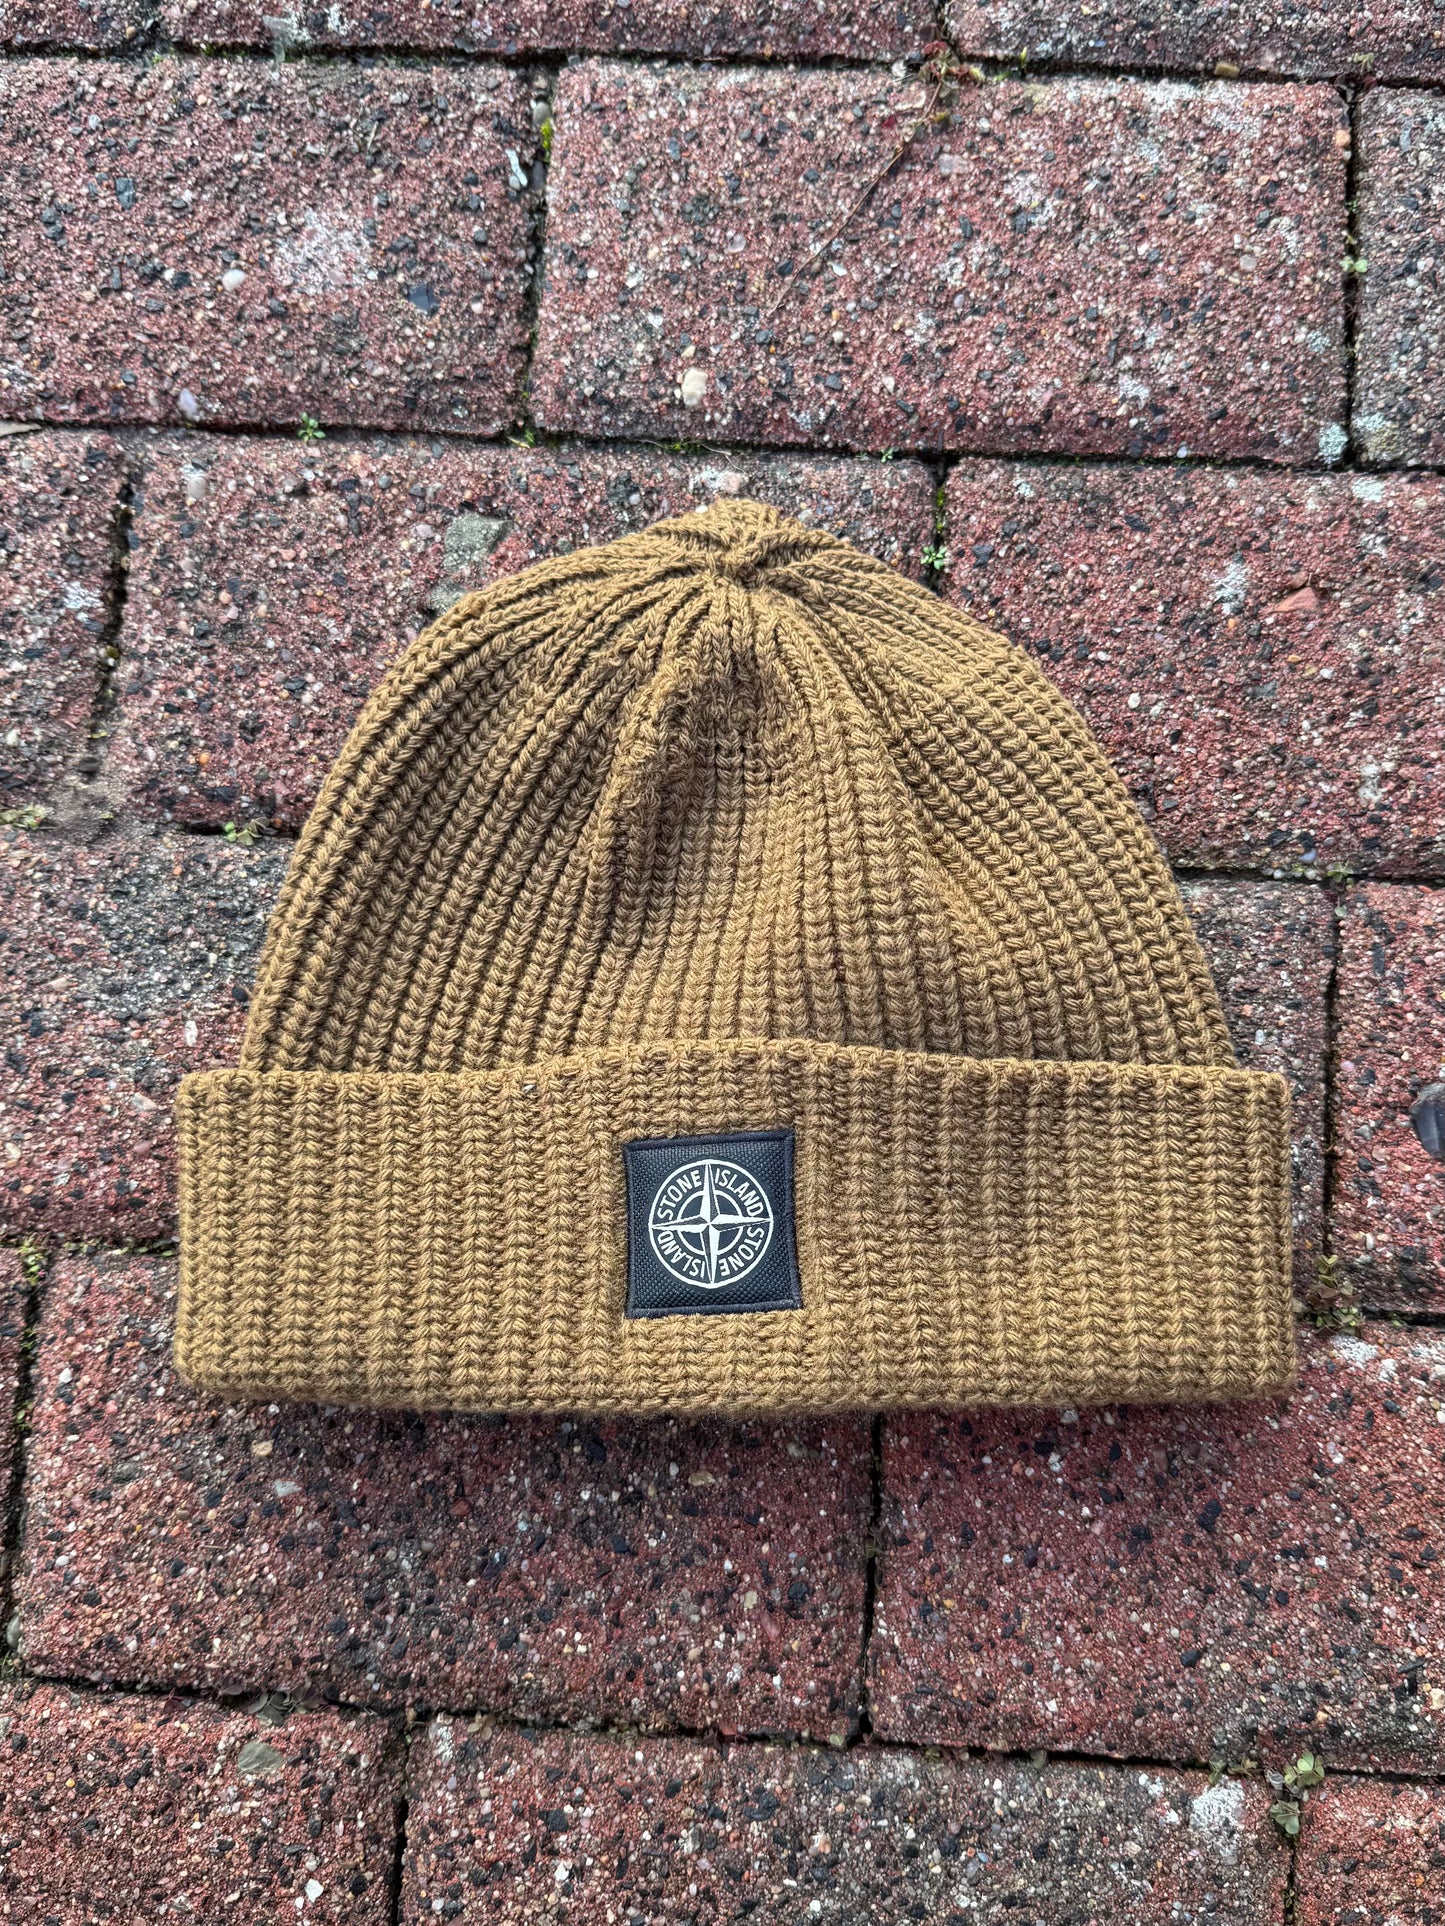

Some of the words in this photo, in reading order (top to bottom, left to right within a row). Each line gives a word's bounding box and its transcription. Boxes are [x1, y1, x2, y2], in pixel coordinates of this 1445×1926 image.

[657, 1169, 702, 1220] STONE
[715, 1167, 764, 1218] ISLAND
[657, 1229, 705, 1278] ISLAND
[719, 1226, 765, 1276] STONE
